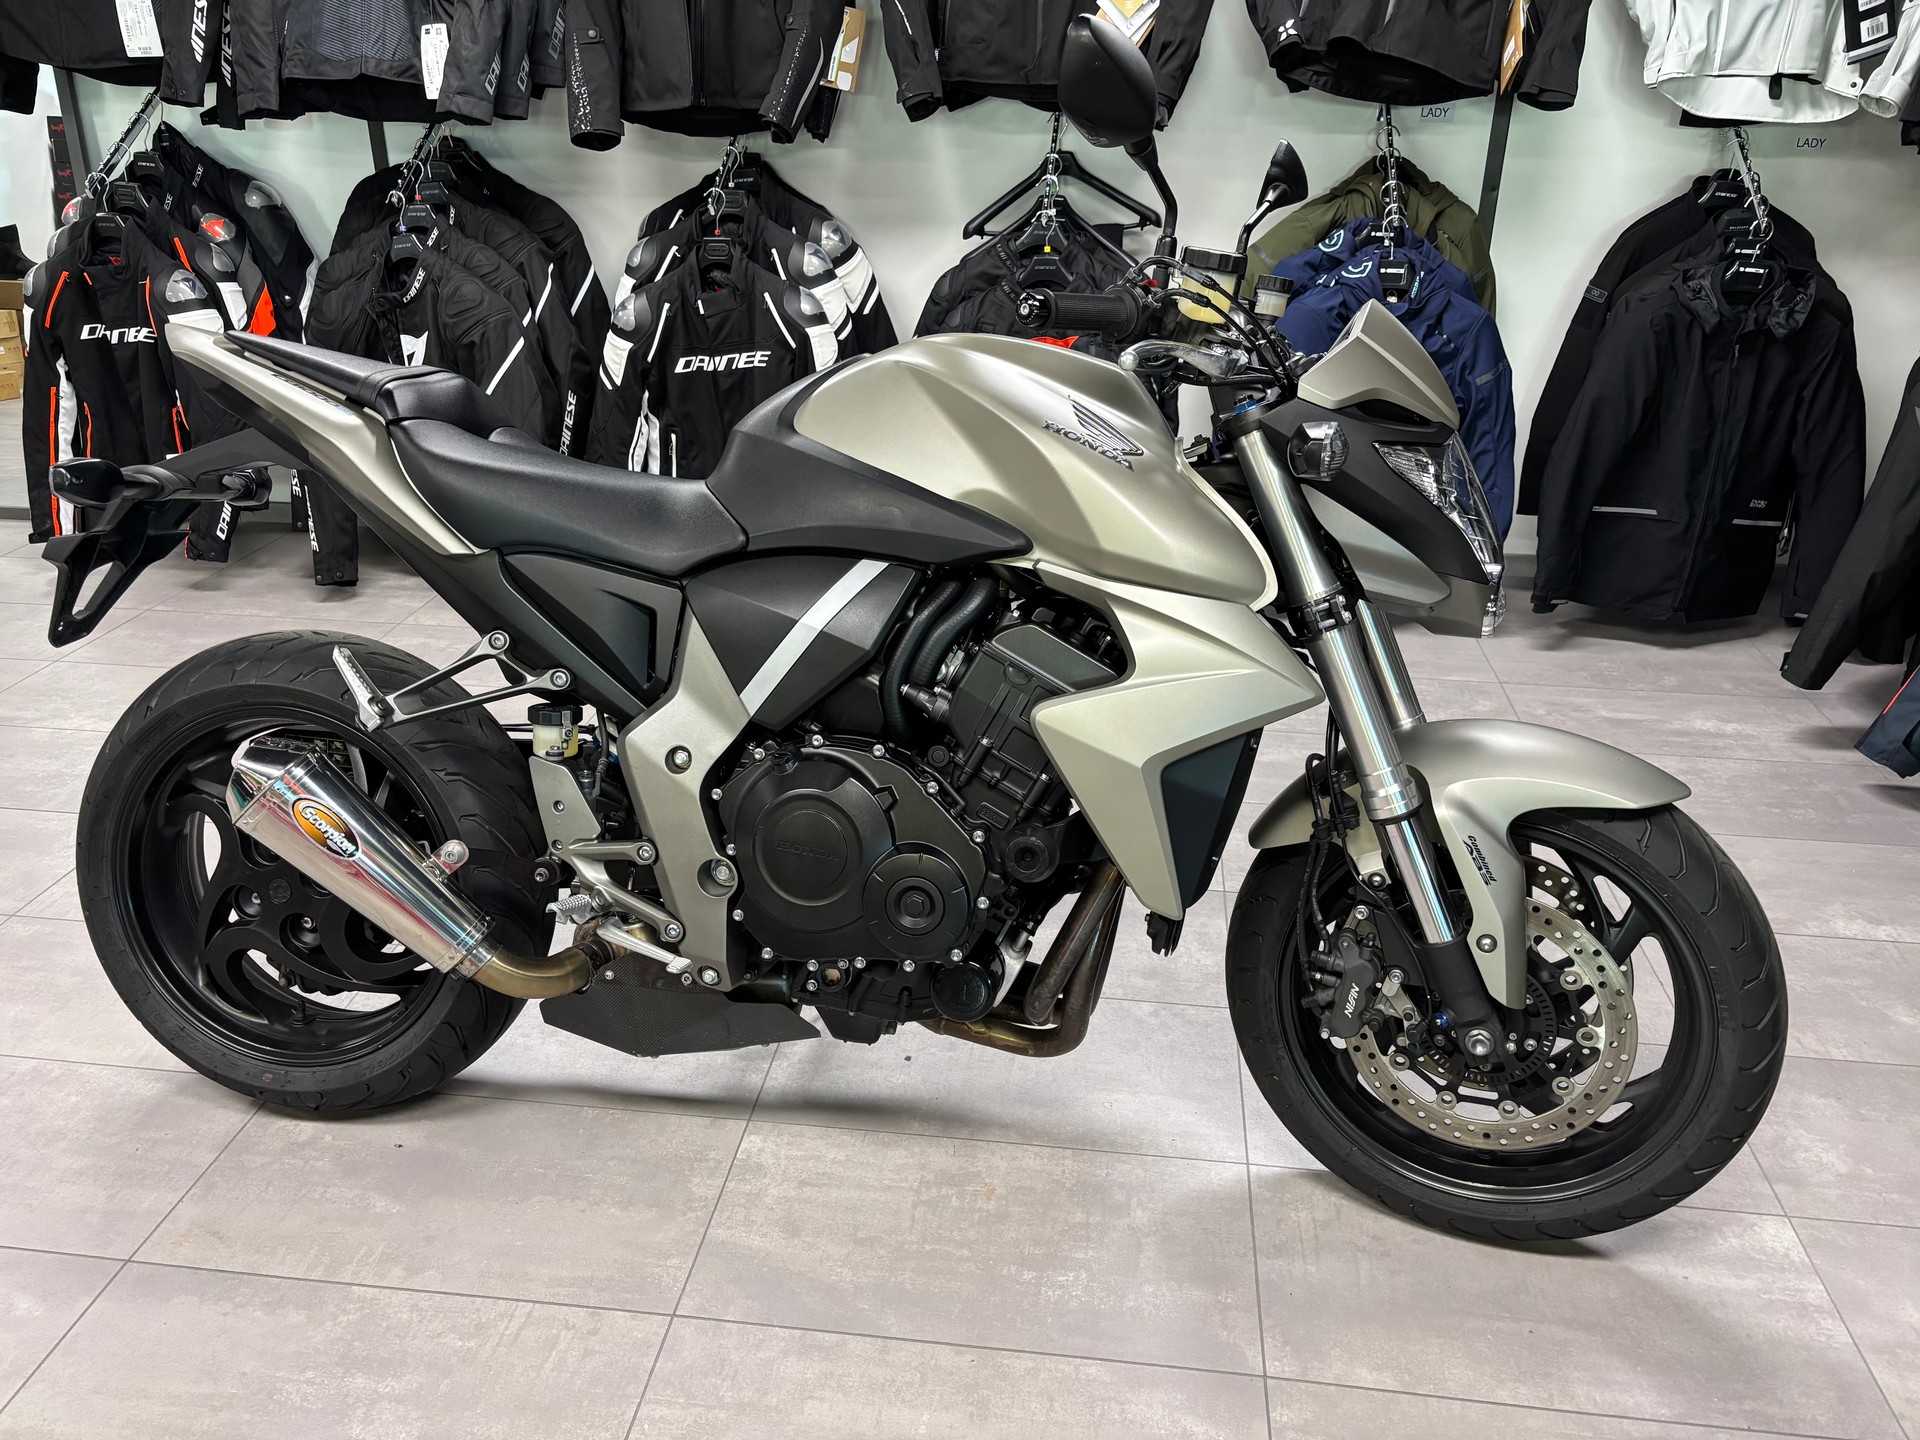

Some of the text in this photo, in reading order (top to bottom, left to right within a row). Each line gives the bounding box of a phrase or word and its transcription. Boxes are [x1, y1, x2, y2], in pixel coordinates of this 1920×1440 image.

[1420, 107, 1450, 118] LADY
[1796, 137, 1827, 148] LADY
[402, 267, 426, 303] DAINESE
[1041, 420, 1135, 473] HONDA
[301, 807, 357, 855] Scorpion
[1467, 835, 1497, 882] Combined
[1343, 982, 1360, 1019] NISSIN
